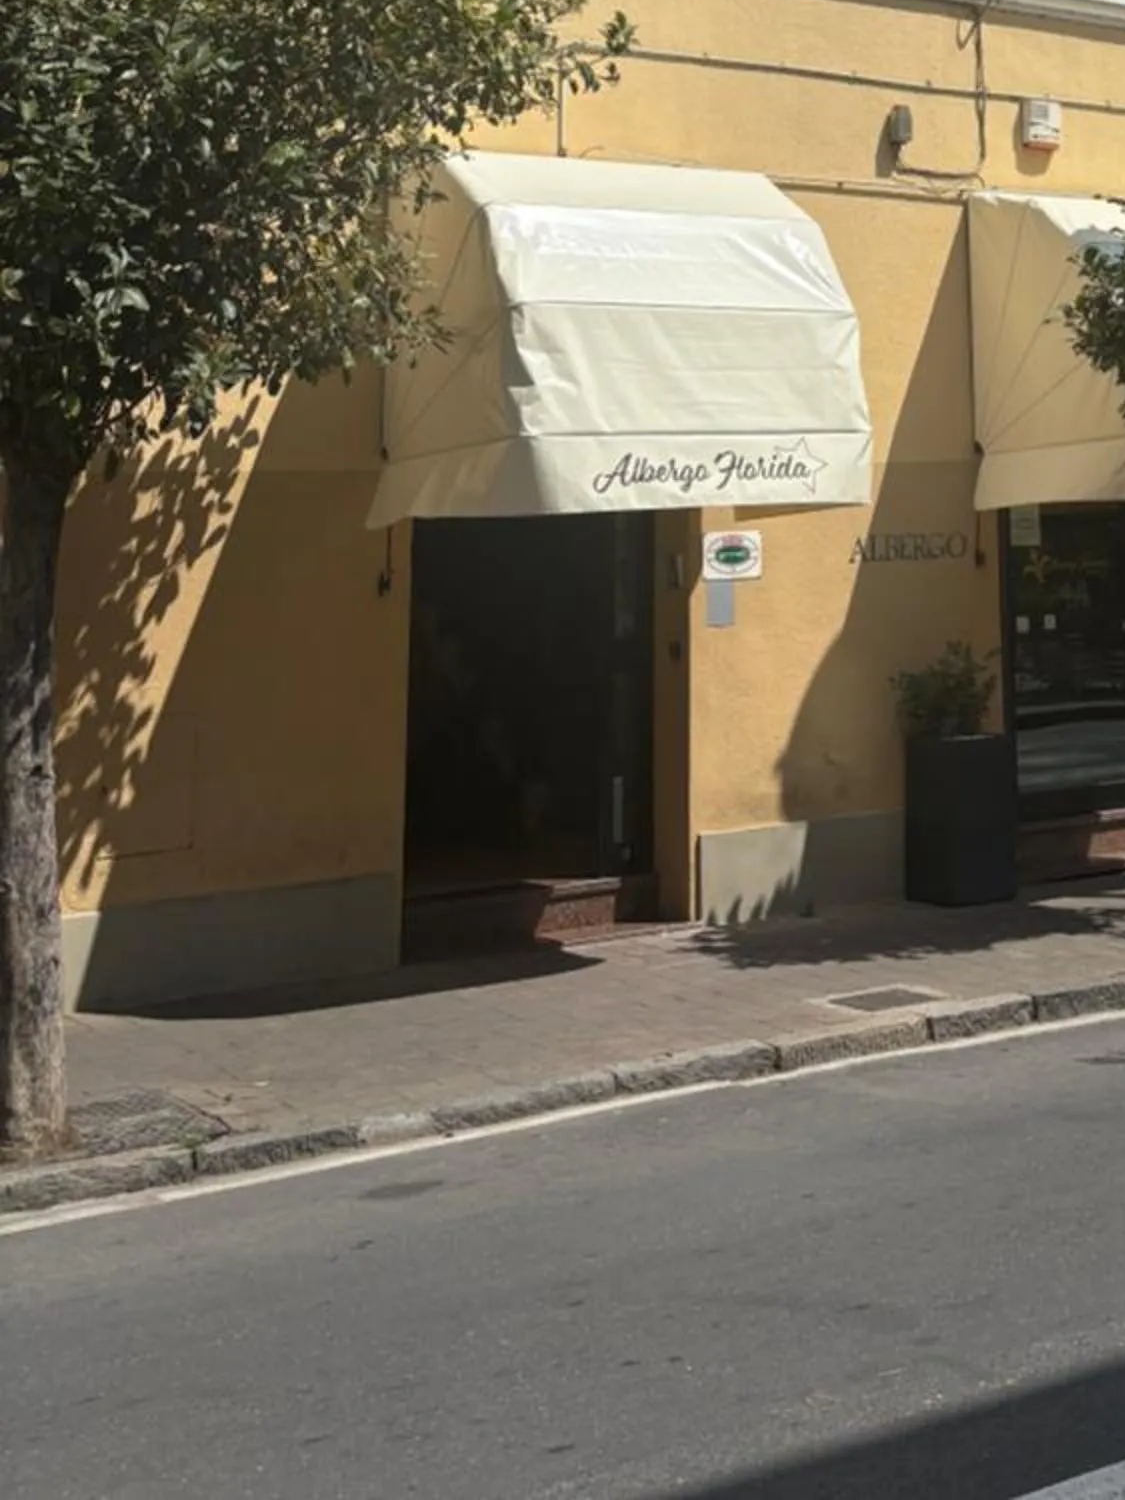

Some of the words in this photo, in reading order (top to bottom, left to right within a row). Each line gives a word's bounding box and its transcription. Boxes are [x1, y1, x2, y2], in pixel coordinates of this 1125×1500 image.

[593, 451, 710, 494] Albergo
[714, 450, 811, 491] Florida
[848, 531, 969, 564] ALBERGO
